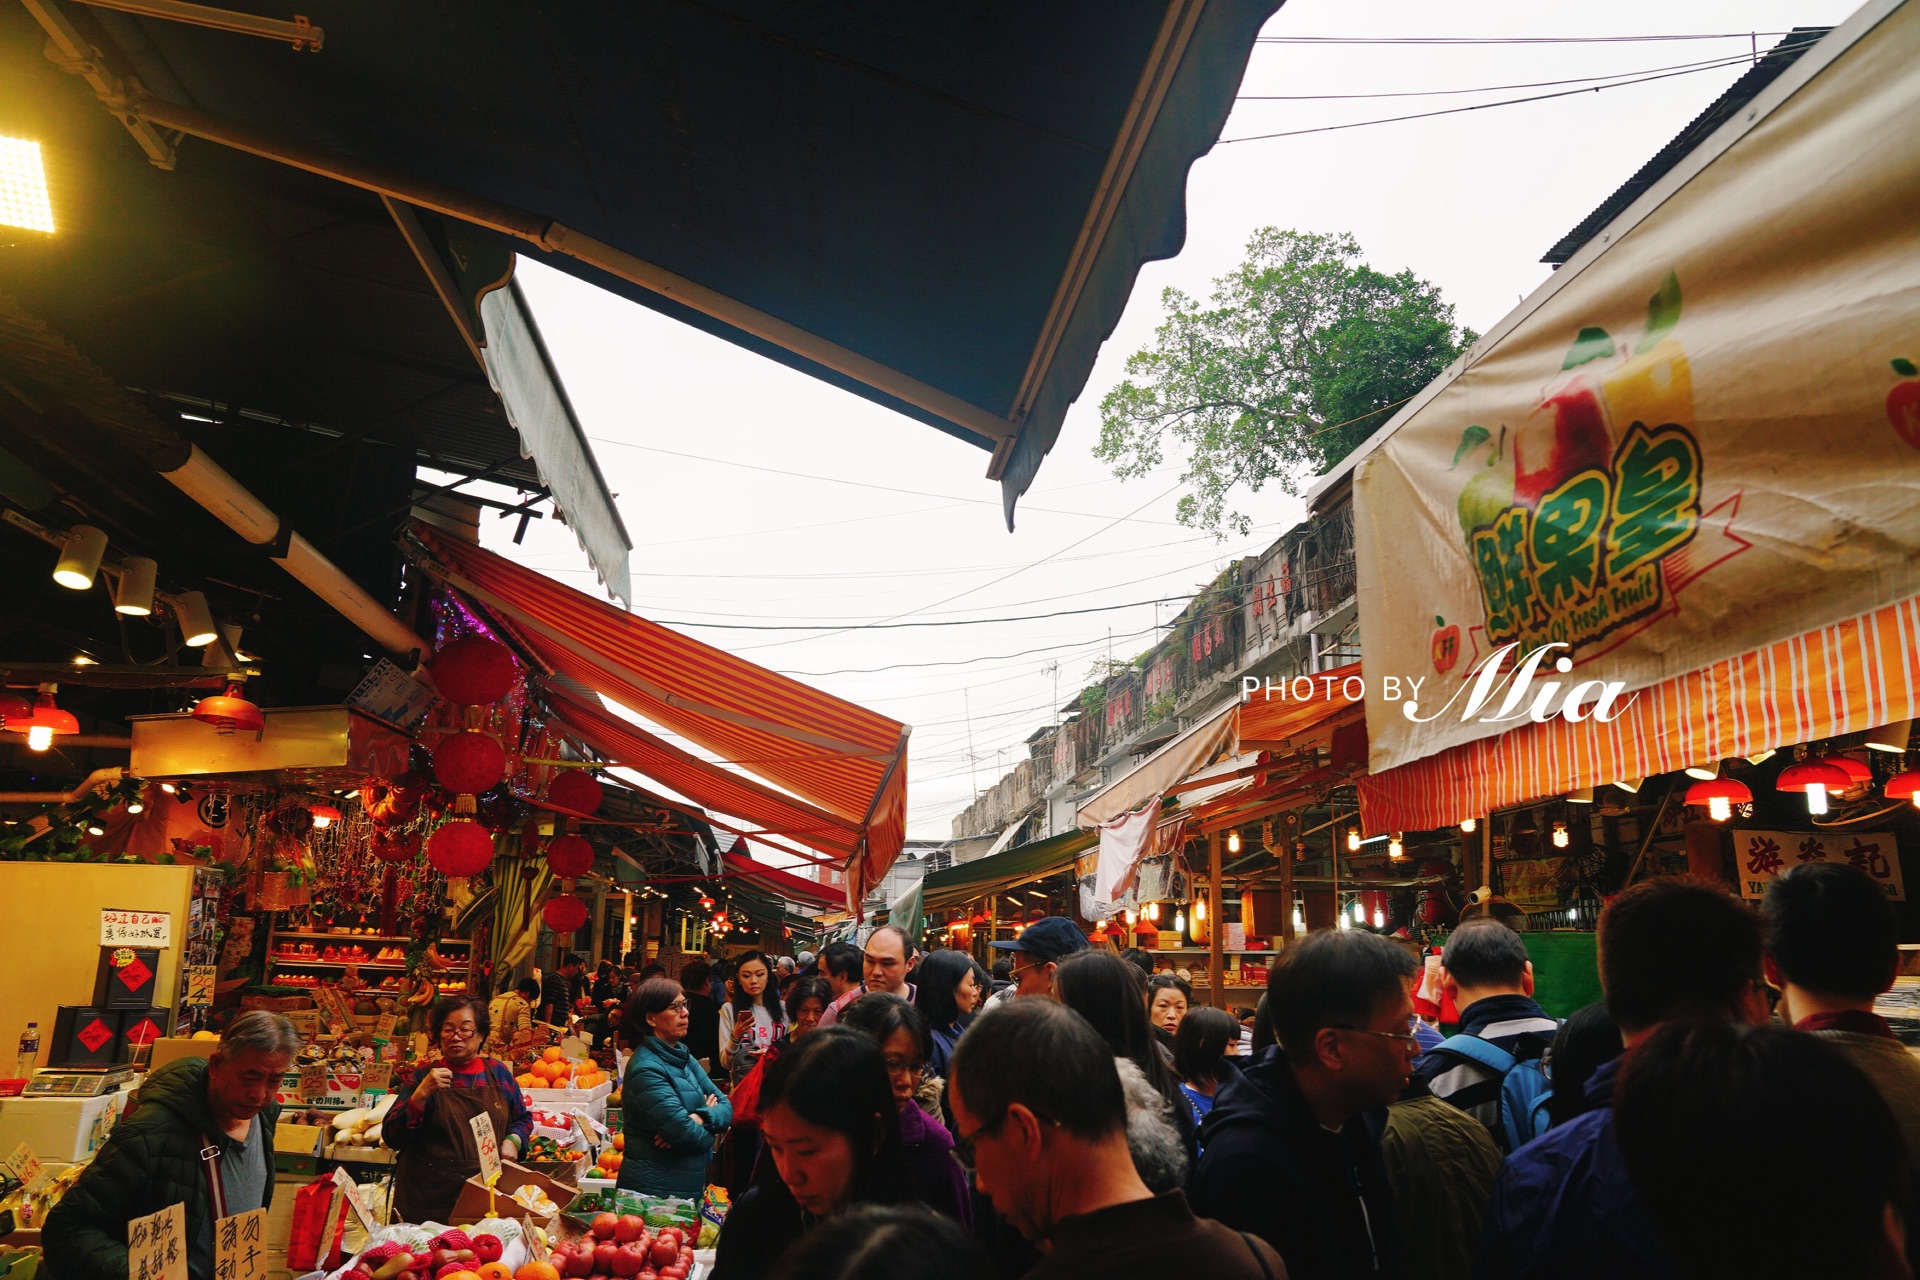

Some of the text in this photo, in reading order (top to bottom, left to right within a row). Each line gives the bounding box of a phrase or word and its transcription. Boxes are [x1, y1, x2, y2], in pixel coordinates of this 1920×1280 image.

[1474, 424, 1701, 643] 鮮果皇
[1551, 616, 1569, 643] Of
[1569, 595, 1610, 635] Fresh
[1610, 569, 1654, 614] Fruit
[220, 1215, 260, 1252] 請勿
[215, 1244, 262, 1279] 動手
